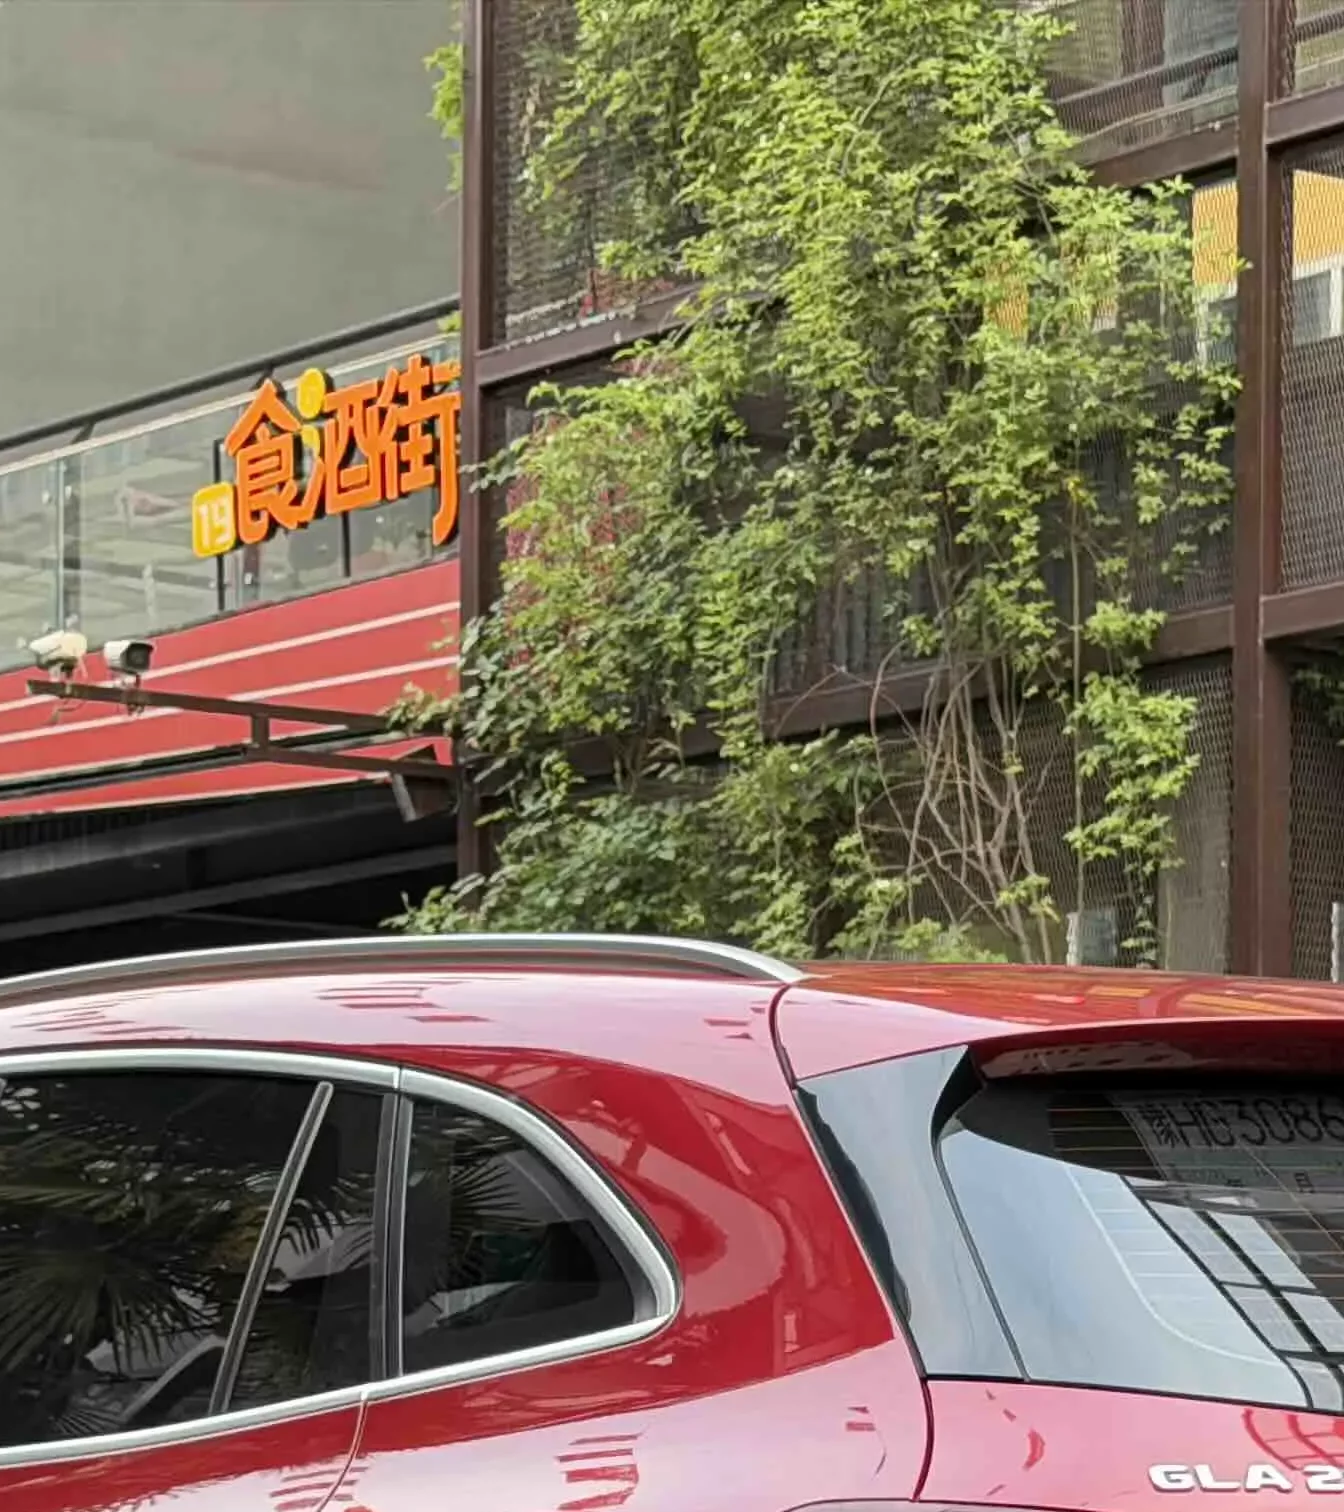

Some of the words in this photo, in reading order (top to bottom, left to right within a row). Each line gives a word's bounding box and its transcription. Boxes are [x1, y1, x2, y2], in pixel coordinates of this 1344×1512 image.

[224, 353, 462, 546] 食酒街
[1147, 1463, 1294, 1493] GLA
